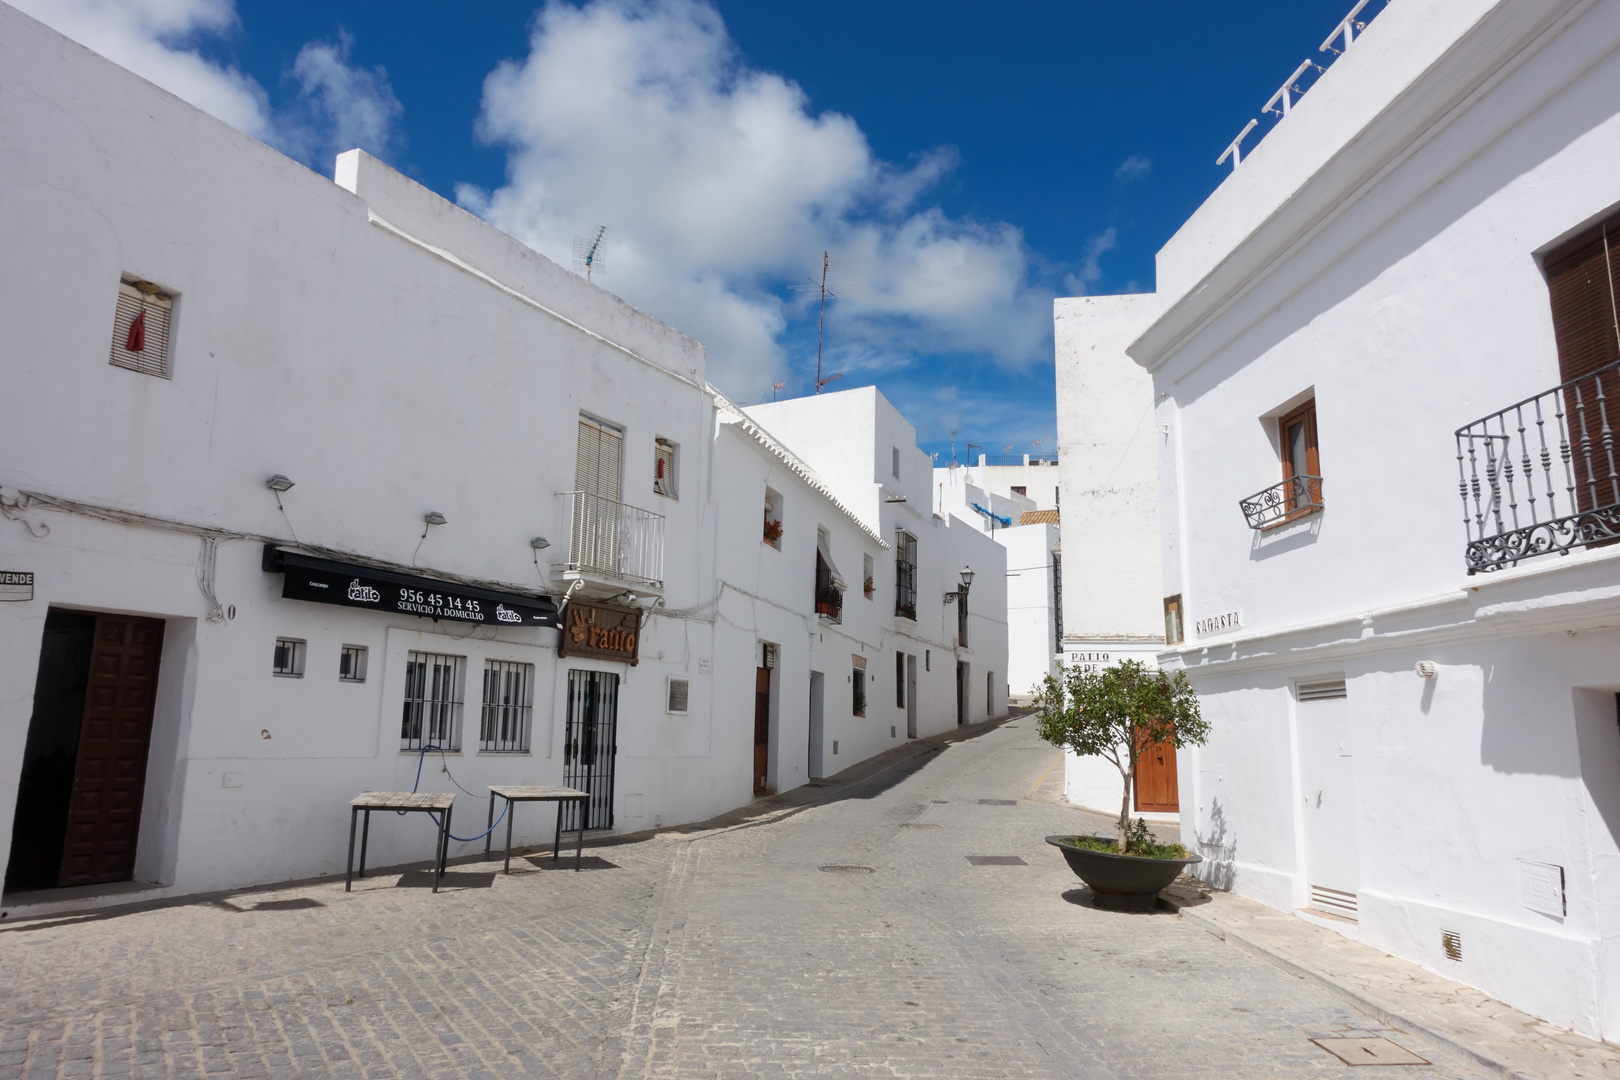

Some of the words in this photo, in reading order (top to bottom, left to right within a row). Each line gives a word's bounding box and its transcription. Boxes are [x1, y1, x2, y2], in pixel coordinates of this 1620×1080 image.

[348, 587, 380, 602] ratito
[400, 588, 424, 603] 956
[428, 593, 443, 606] 45
[447, 597, 462, 609] 14
[465, 600, 480, 612] 45
[397, 601, 434, 614] SERVICIO
[435, 607, 442, 615] A
[444, 608, 484, 621] DOMICILIO
[1196, 612, 1239, 634] SAGASTA
[588, 626, 635, 653] ratito
[1071, 652, 1109, 661] PATIO
[1084, 663, 1098, 672] DE
